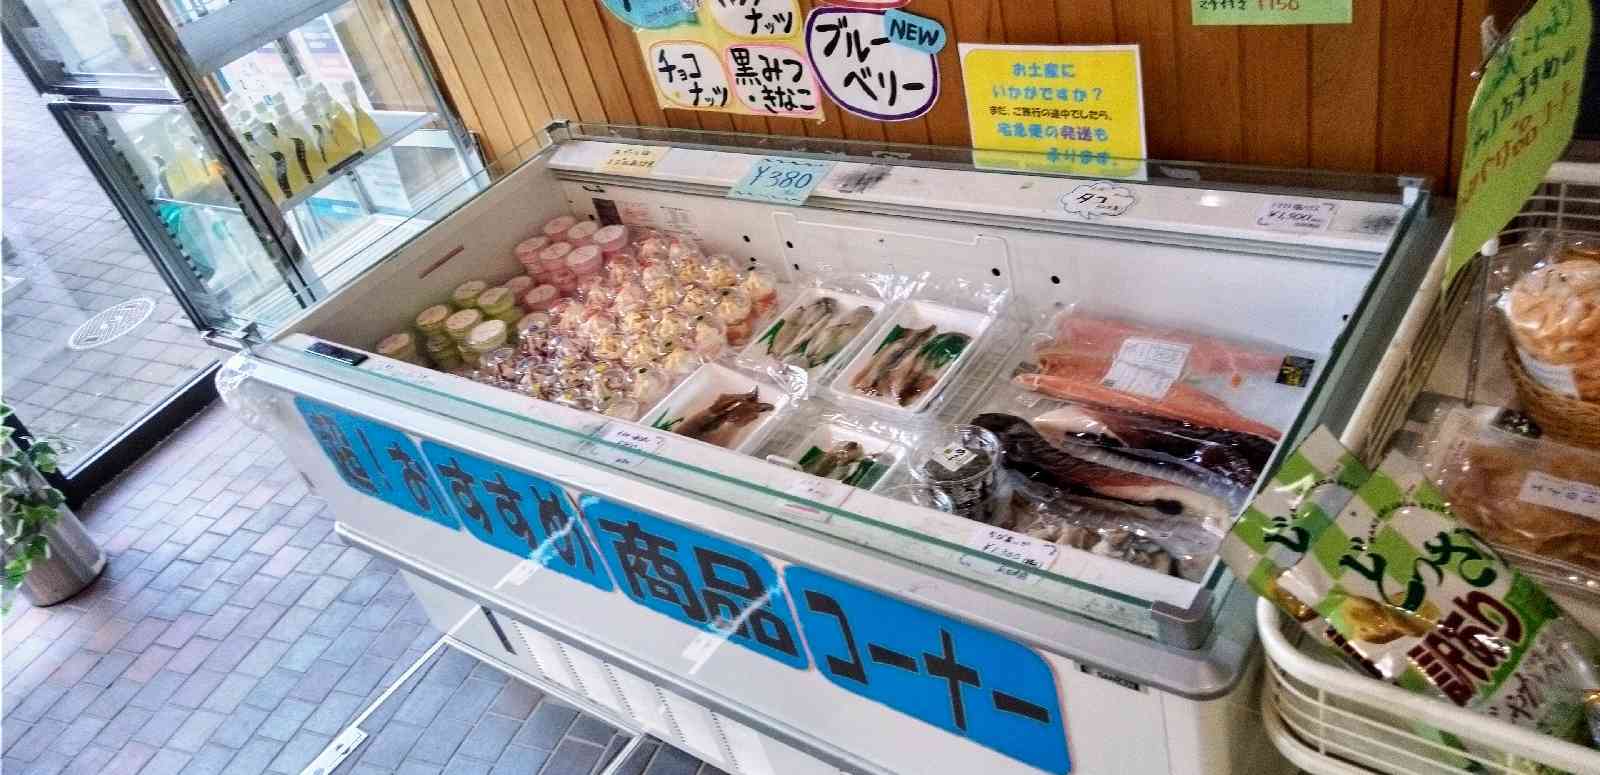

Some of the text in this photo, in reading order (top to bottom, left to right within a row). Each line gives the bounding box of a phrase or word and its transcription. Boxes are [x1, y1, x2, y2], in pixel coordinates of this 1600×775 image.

[745, 8, 793, 34] ナッツ
[889, 19, 939, 46] NEW
[815, 19, 890, 63] ブルー
[658, 49, 701, 83] チョコ
[730, 48, 804, 86] 黒みつ
[1012, 62, 1077, 78] お土産に
[688, 81, 728, 106] ナッツ
[843, 67, 925, 106] ベリー
[992, 86, 1104, 102] いかがですか？
[748, 165, 812, 189] ¥380
[1407, 590, 1523, 707] 訳あり
